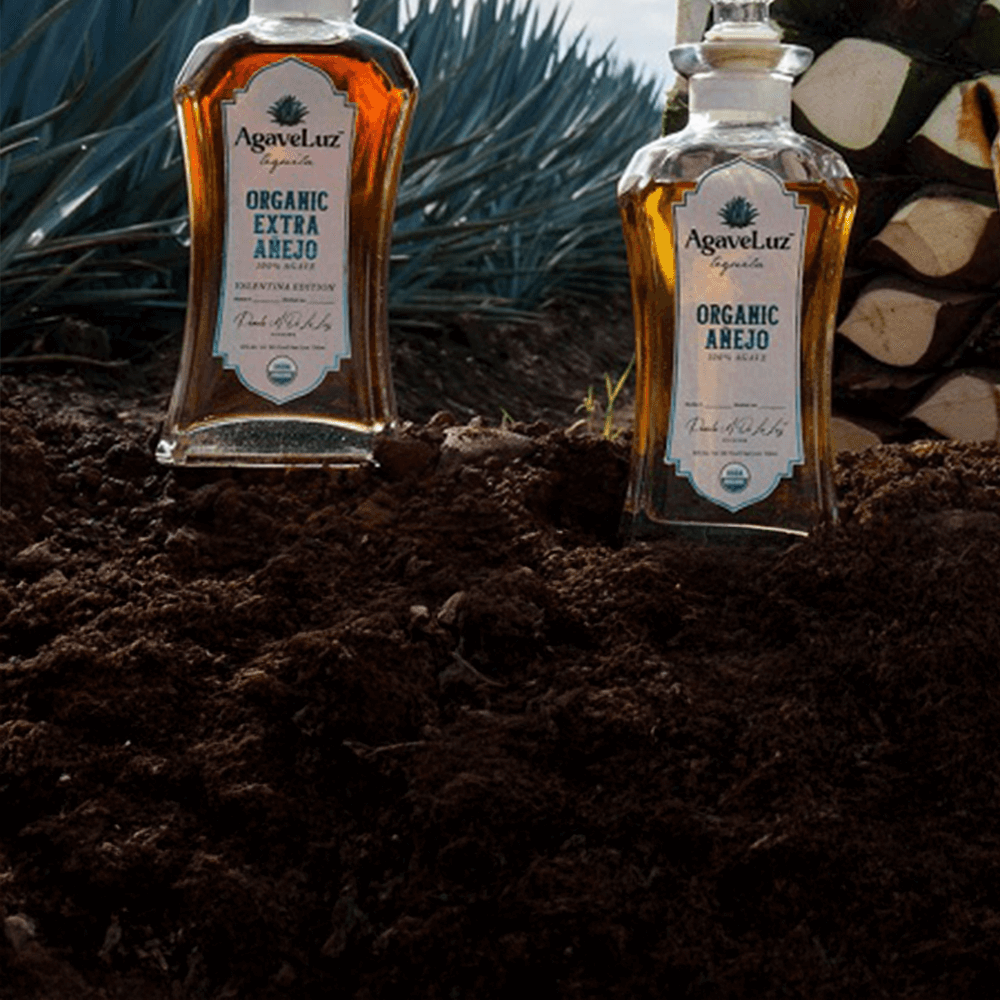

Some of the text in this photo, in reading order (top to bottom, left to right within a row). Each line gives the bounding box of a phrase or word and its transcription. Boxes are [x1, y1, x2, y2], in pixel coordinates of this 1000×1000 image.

[235, 126, 341, 154] AgaveLuz
[246, 190, 329, 211] ORGANIC
[253, 214, 319, 235] EXTRA
[253, 236, 318, 260] AÑEJO
[685, 228, 791, 256] AgaveLuz
[696, 304, 779, 325] ORGANIC
[705, 326, 770, 350] AÑEJO
